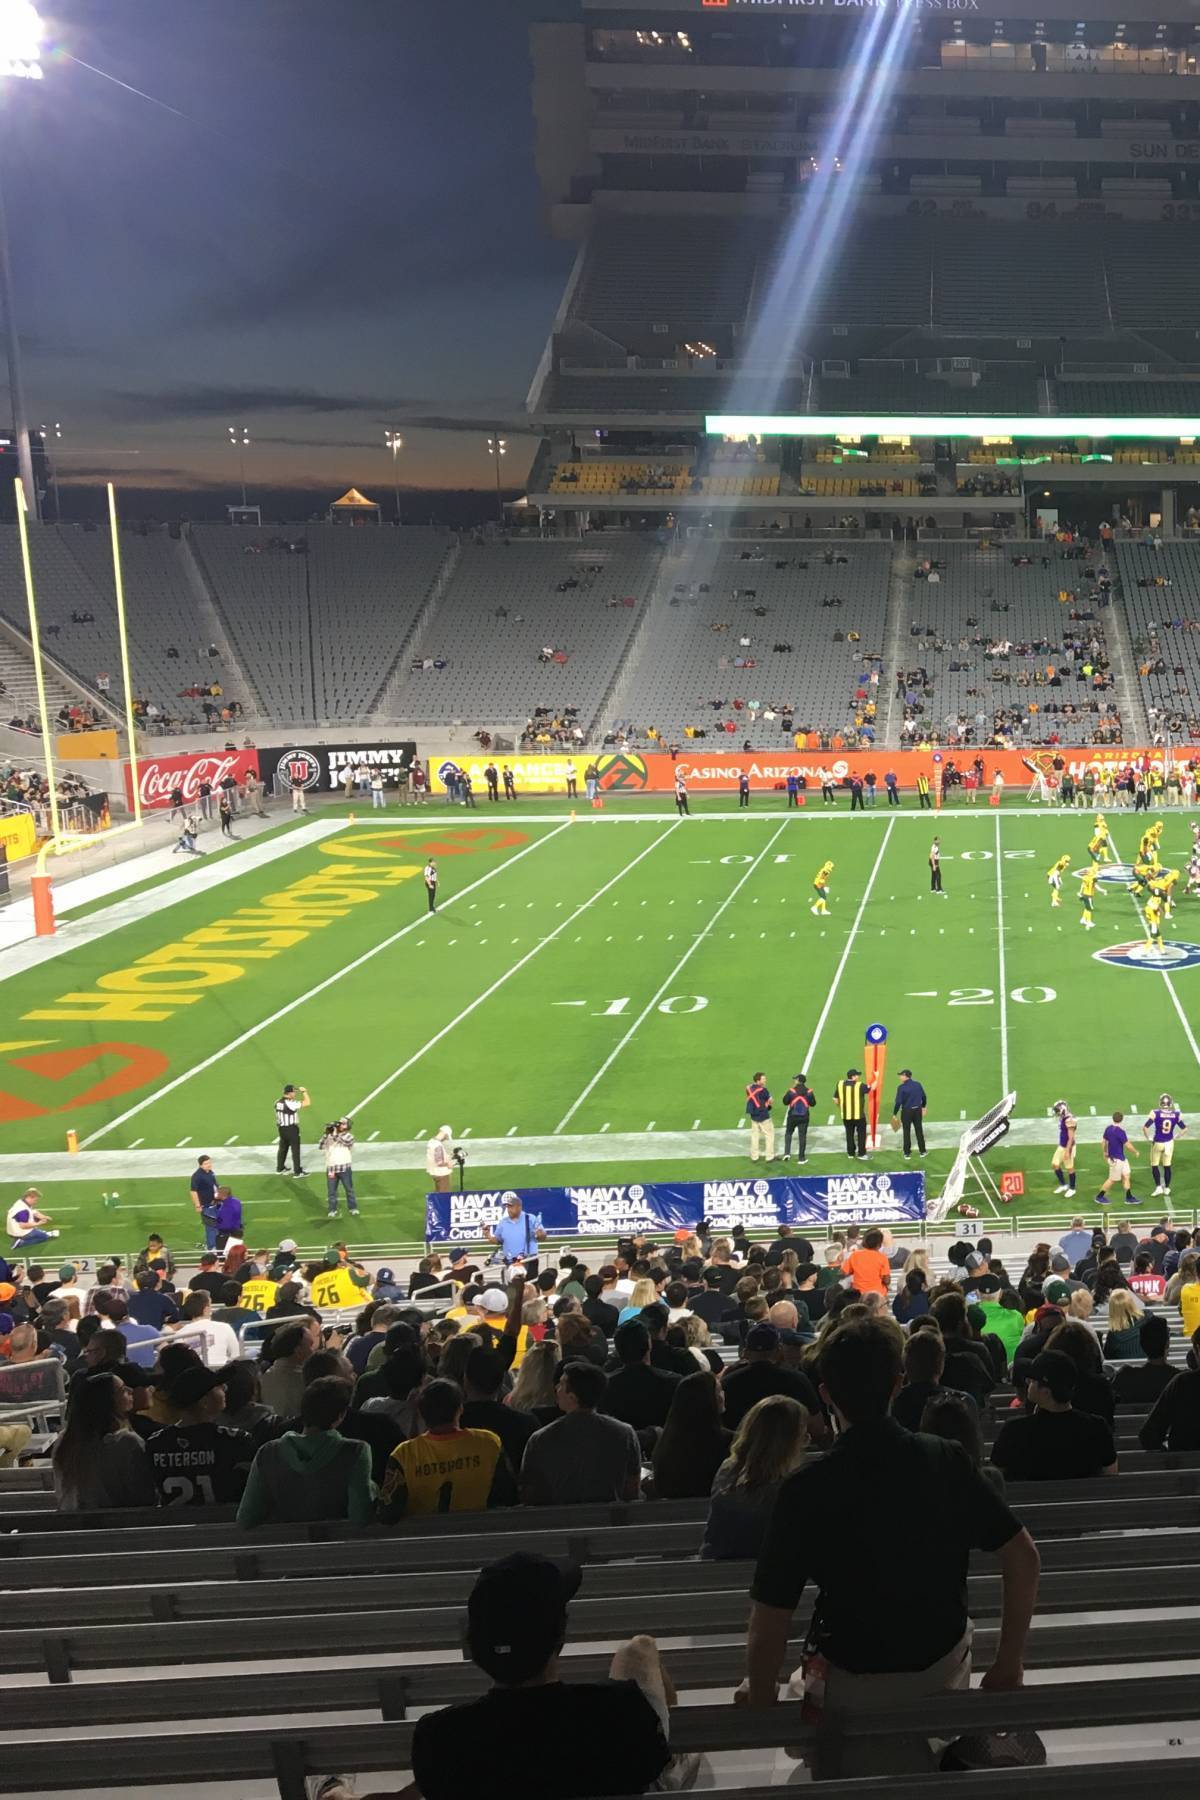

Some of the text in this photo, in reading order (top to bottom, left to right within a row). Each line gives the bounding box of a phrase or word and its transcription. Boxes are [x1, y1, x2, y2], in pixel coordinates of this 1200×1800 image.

[1130, 143, 1168, 159] SUN
[328, 749, 404, 769] JIMMY
[19, 863, 424, 1022] HOTSHOTS
[947, 985, 1057, 1006] 20
[591, 994, 709, 1016] 10
[1161, 1119, 1172, 1134] 9
[704, 1181, 752, 1197] NAVY
[827, 1177, 874, 1193] NAVY
[1005, 1175, 1022, 1193] 20
[450, 1191, 500, 1209] NAVY
[575, 1186, 626, 1202] NAVY
[704, 1194, 777, 1211] FEDERAL
[827, 1189, 900, 1206] FEDERAL
[577, 1199, 652, 1216] FEDERAL
[449, 1227, 484, 1240] Credi
[962, 1223, 978, 1235] 31
[1131, 1279, 1161, 1293] PINK
[153, 1450, 216, 1468] PETERSON
[415, 1455, 481, 1477] HOTSHOTS
[163, 1475, 216, 1506] 21
[439, 1480, 453, 1513] 1
